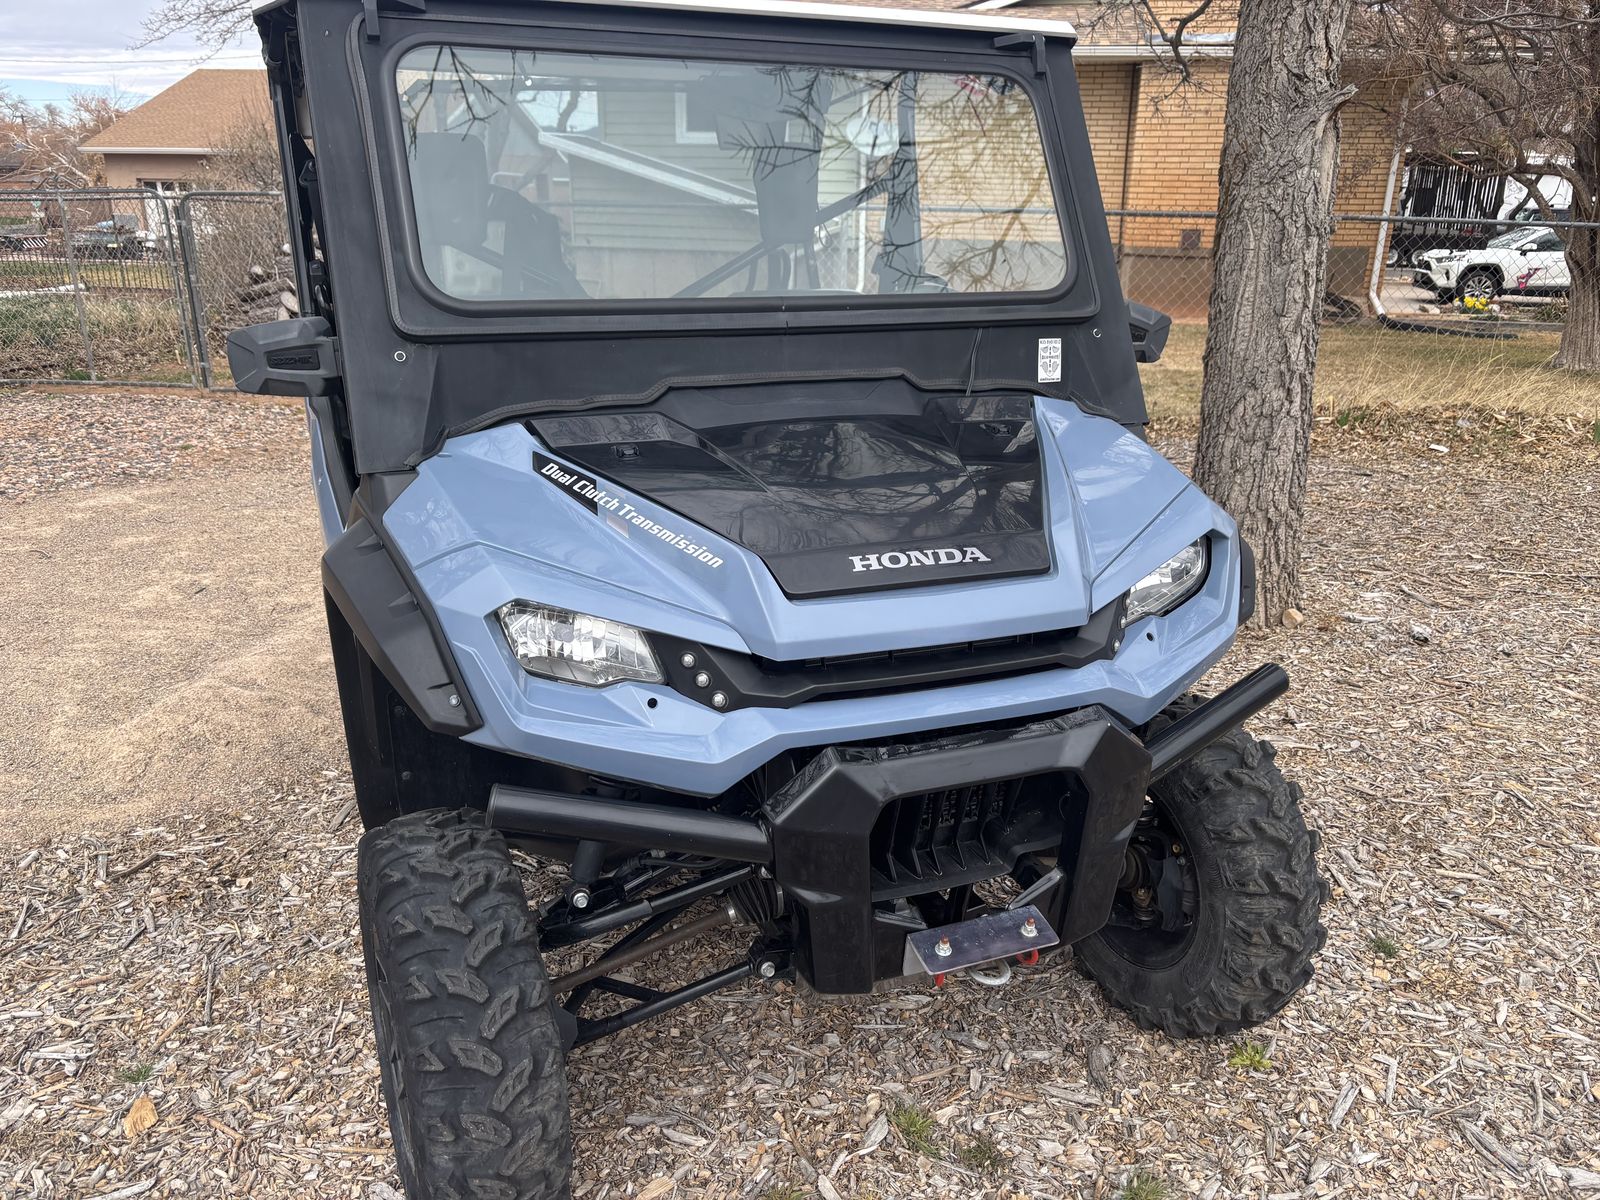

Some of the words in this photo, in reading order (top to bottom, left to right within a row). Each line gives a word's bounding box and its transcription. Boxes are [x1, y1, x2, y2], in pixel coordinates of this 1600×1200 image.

[541, 462, 575, 486] Dual
[572, 480, 620, 512] Clutch
[617, 503, 724, 569] Transmission
[849, 547, 991, 572] HONDA
